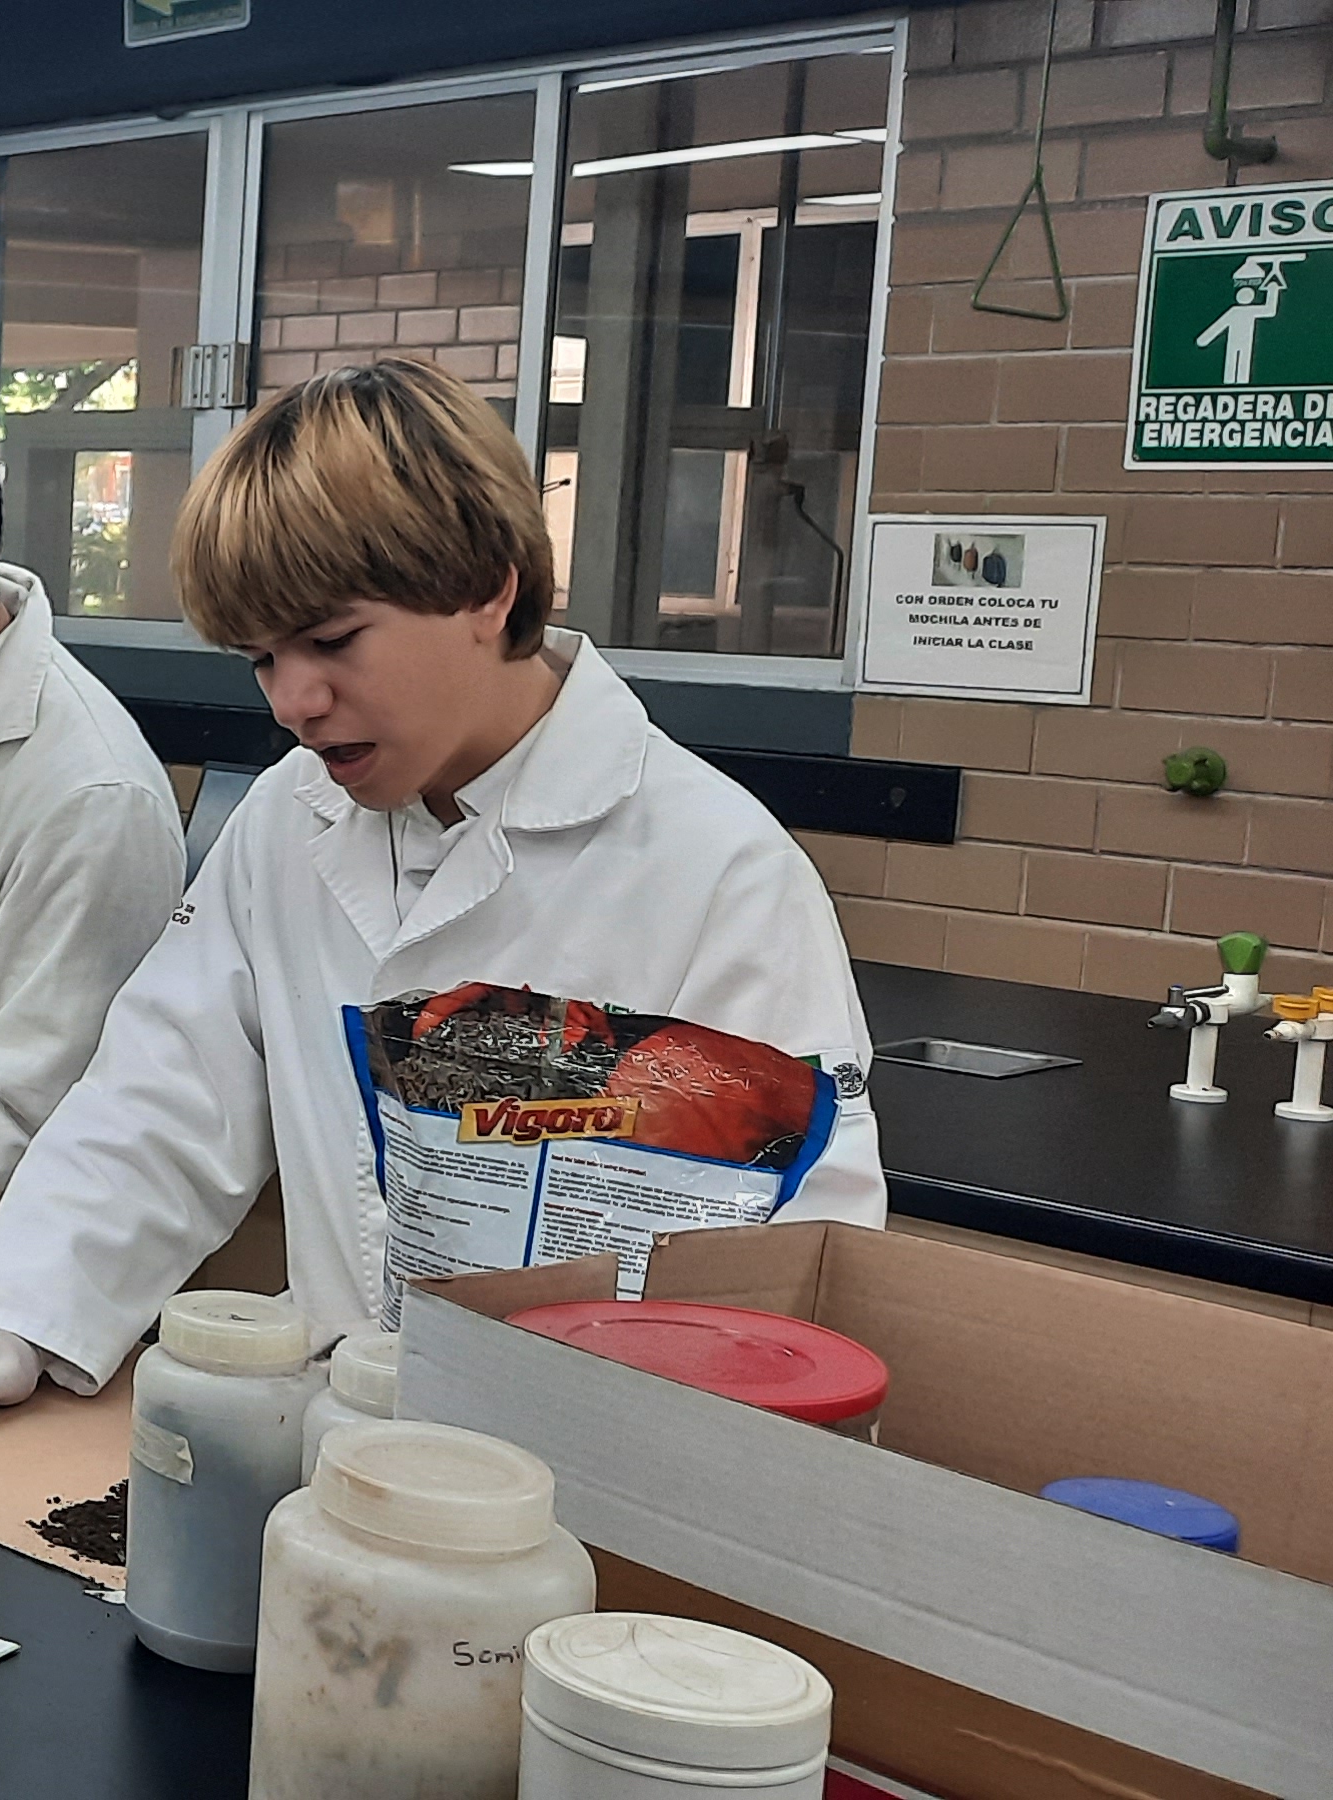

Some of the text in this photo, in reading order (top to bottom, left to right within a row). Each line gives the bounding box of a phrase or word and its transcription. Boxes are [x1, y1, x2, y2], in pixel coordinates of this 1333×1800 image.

[1139, 394, 1295, 421] REGADERA
[1142, 421, 1333, 447] EMERGENCIA
[896, 595, 1059, 609] CON ORDEN COLOCA TU
[909, 614, 1042, 628] MOCHILA ANTES DE
[913, 636, 1034, 650] INICIAR LA CLASE
[473, 1098, 624, 1141] Vigoro
